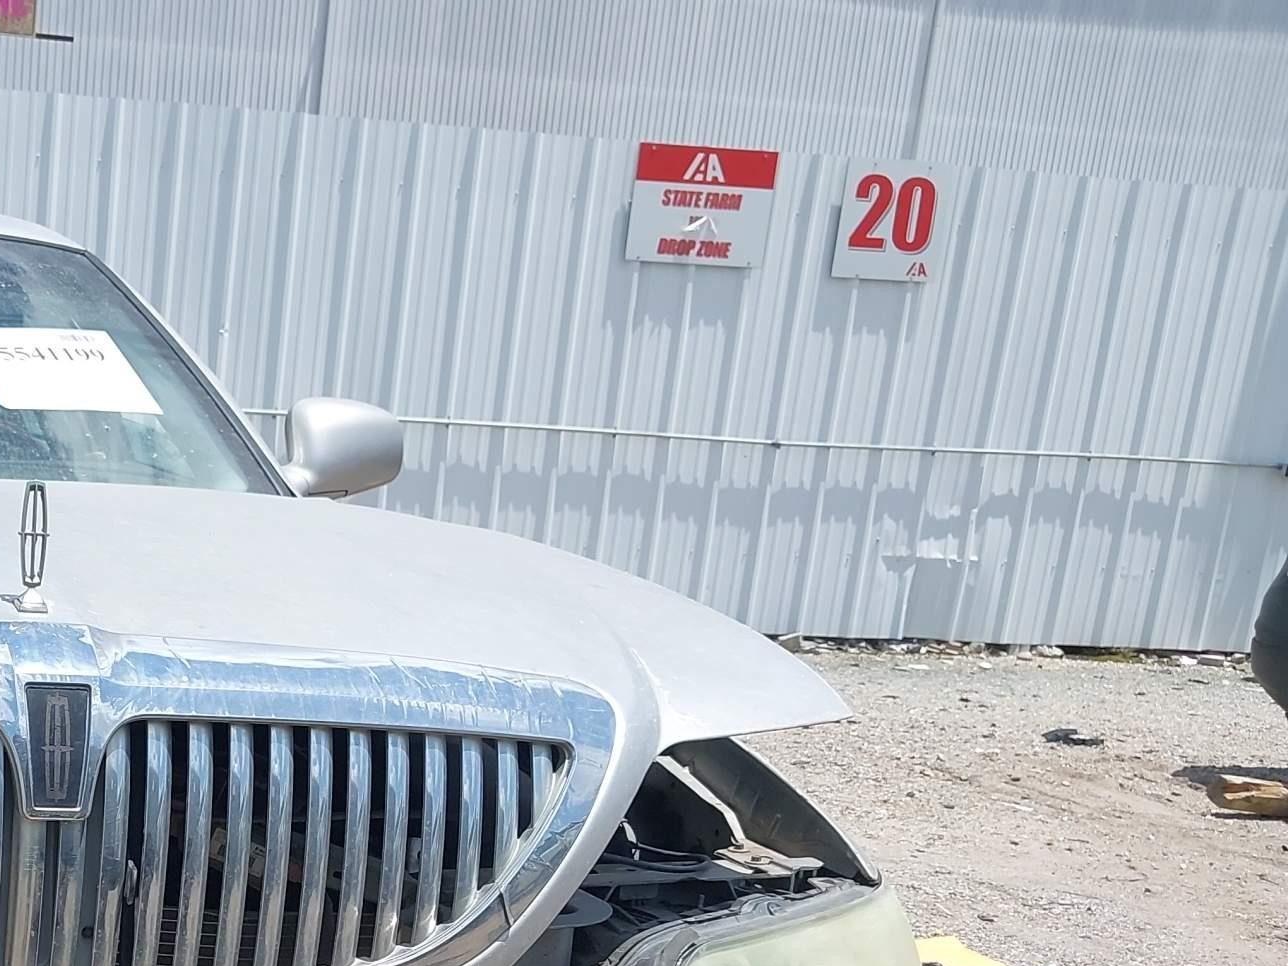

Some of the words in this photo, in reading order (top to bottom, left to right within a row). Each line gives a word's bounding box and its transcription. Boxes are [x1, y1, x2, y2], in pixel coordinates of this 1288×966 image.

[662, 189, 703, 208] STATE
[704, 193, 743, 211] FARM
[848, 174, 937, 254] 20
[657, 238, 695, 256] DROP
[695, 240, 732, 259] ZONE
